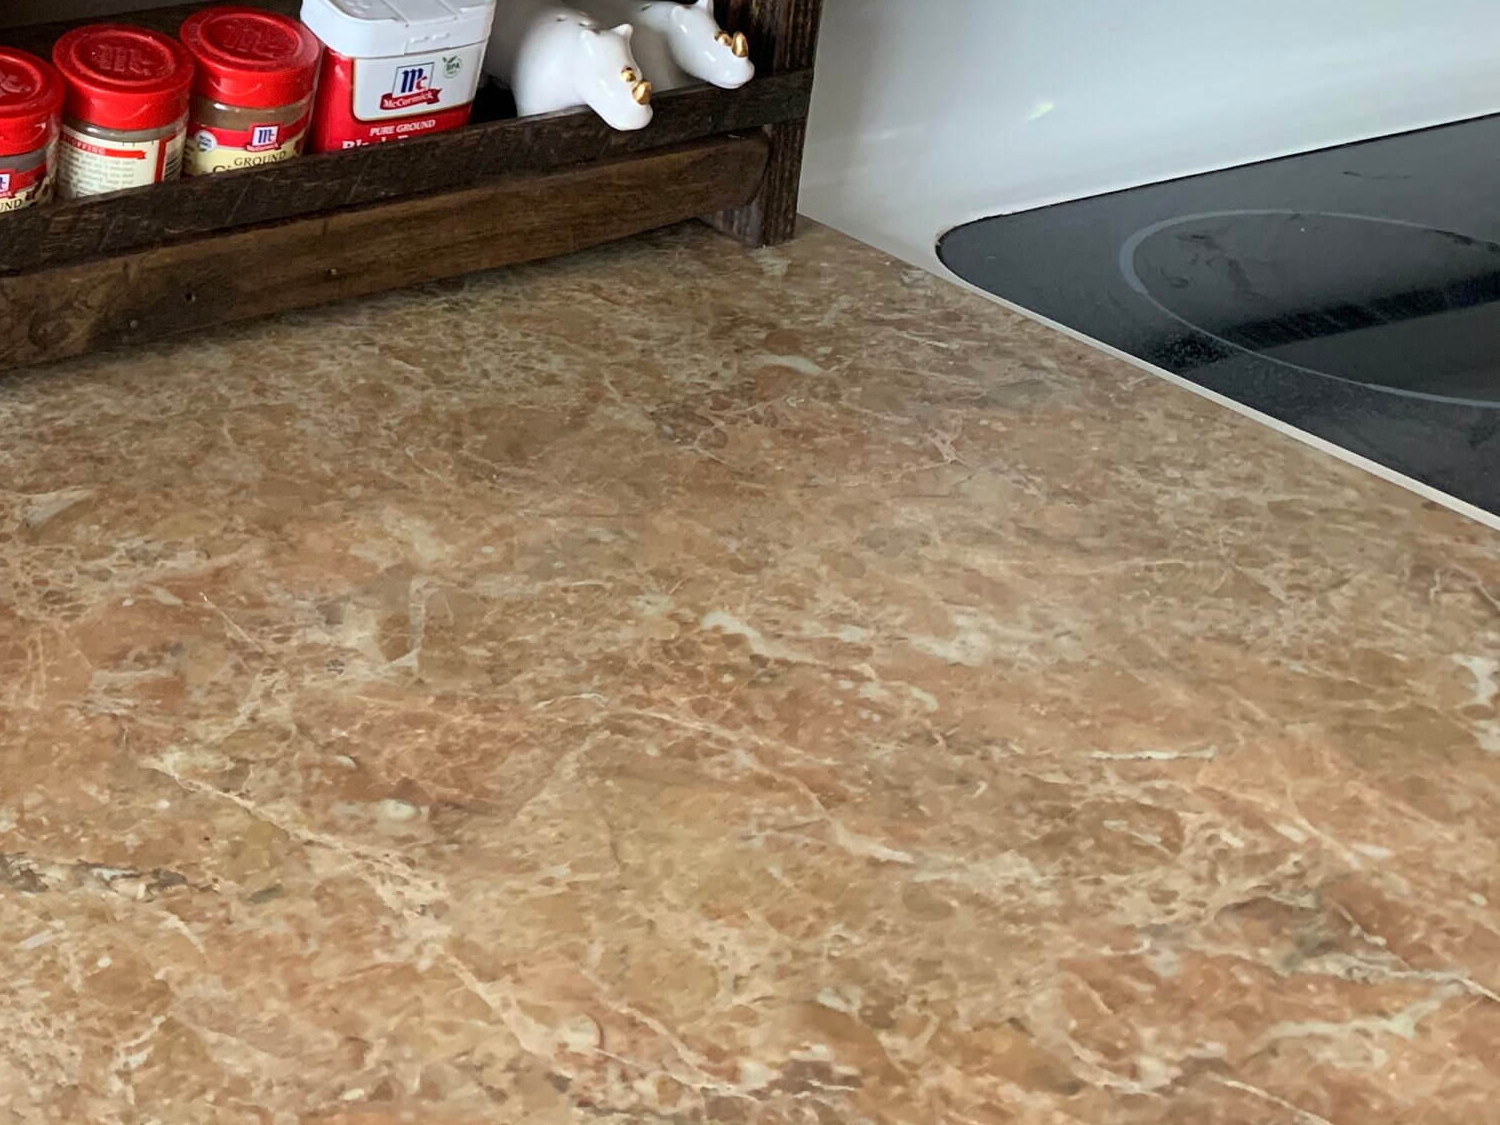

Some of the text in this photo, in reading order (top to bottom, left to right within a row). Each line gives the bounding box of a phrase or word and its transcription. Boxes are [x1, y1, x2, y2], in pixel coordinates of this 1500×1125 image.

[382, 91, 434, 108] McCormick
[370, 119, 436, 136] PURE GROUND
[234, 151, 287, 167] GROUND
